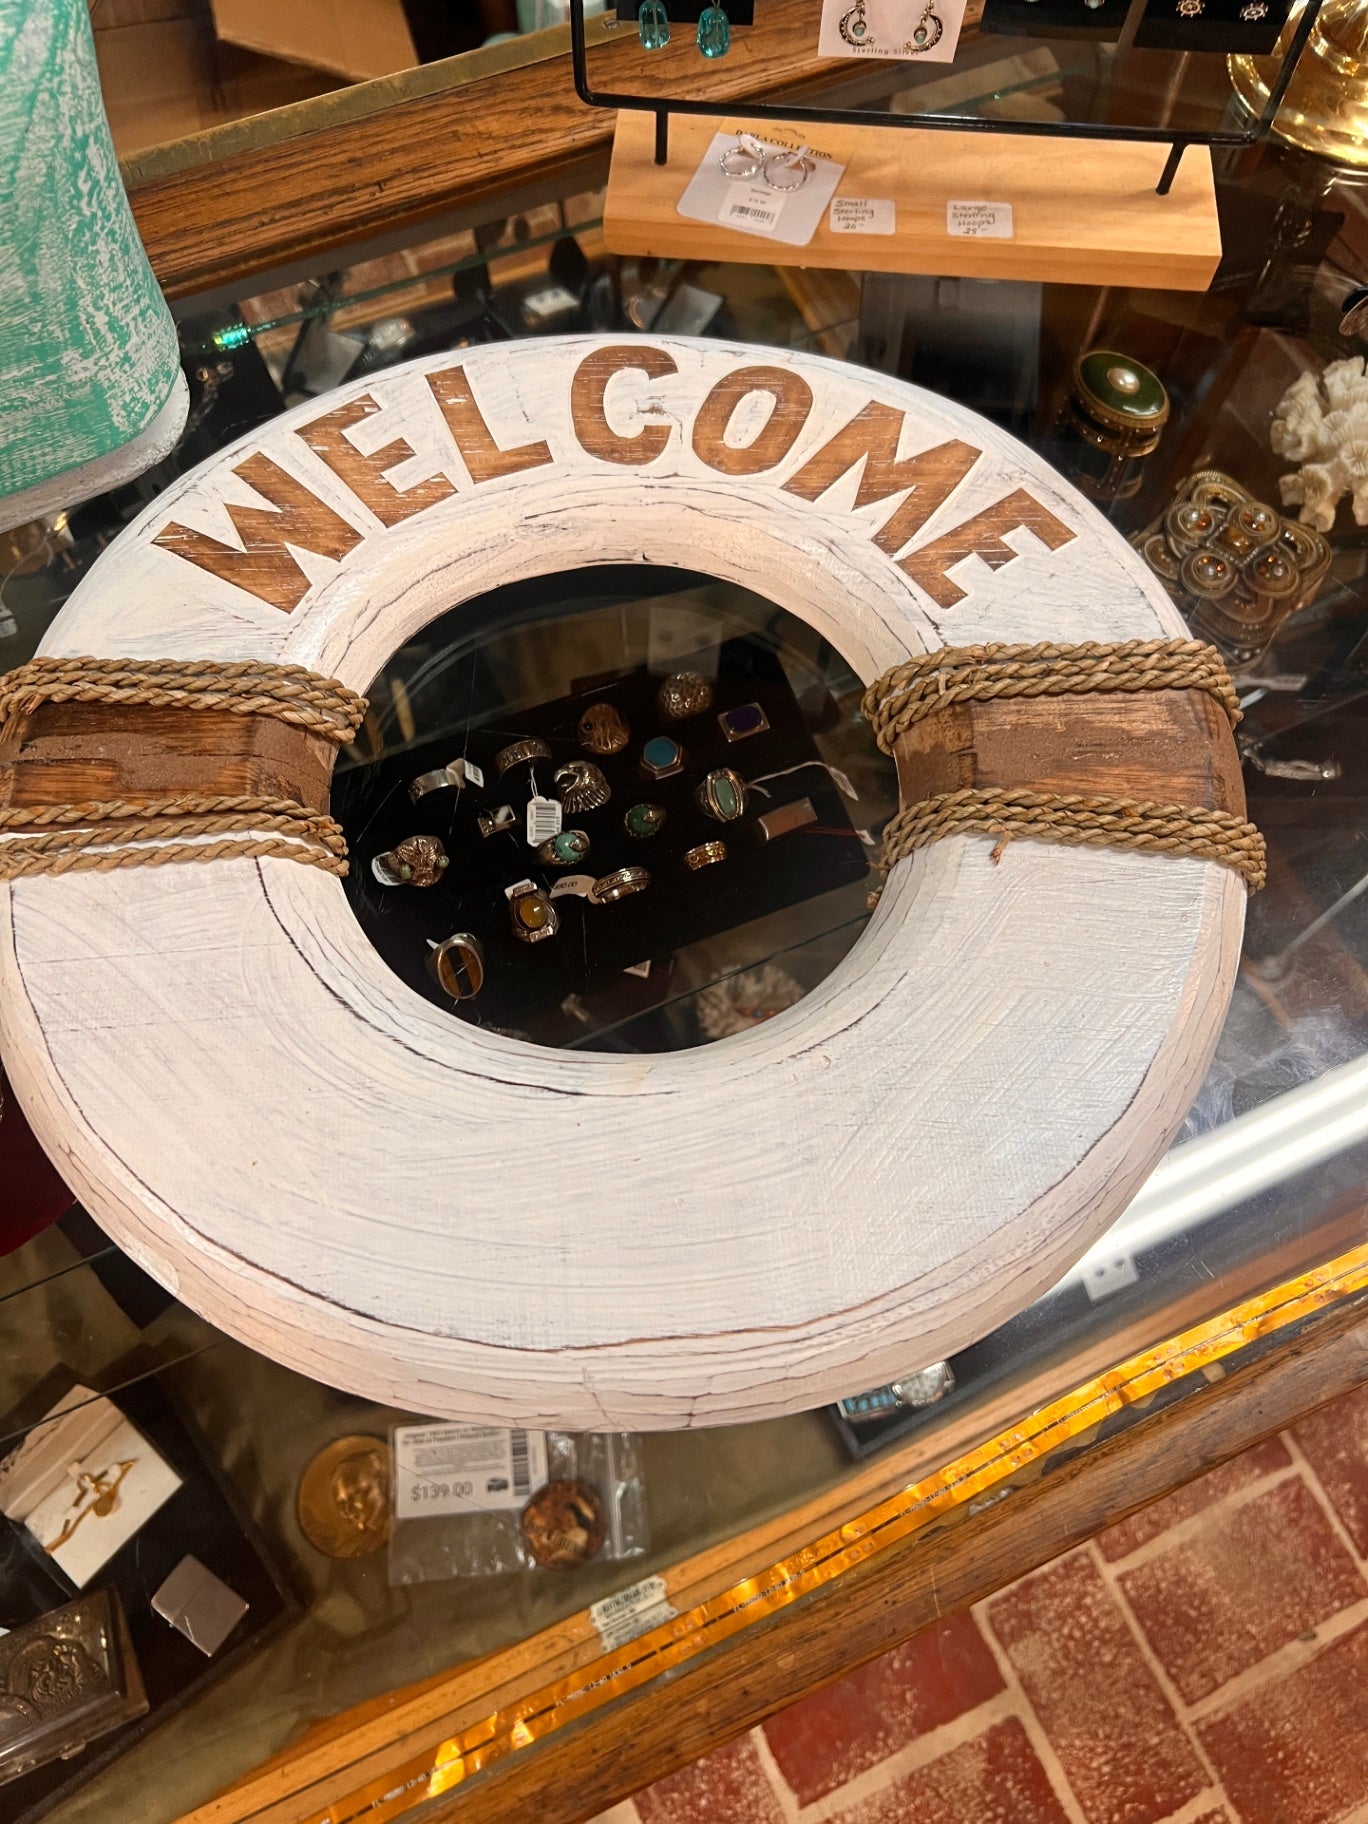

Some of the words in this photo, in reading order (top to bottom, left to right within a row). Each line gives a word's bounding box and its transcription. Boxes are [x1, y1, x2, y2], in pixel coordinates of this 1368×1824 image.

[851, 46, 890, 56] Sterling
[769, 138, 833, 160] COLLETION
[834, 199, 868, 208] Small
[953, 204, 988, 214] Large
[832, 207, 875, 219] Sterling
[151, 344, 1078, 614] WELCOME
[410, 1481, 474, 1502] $139.00
